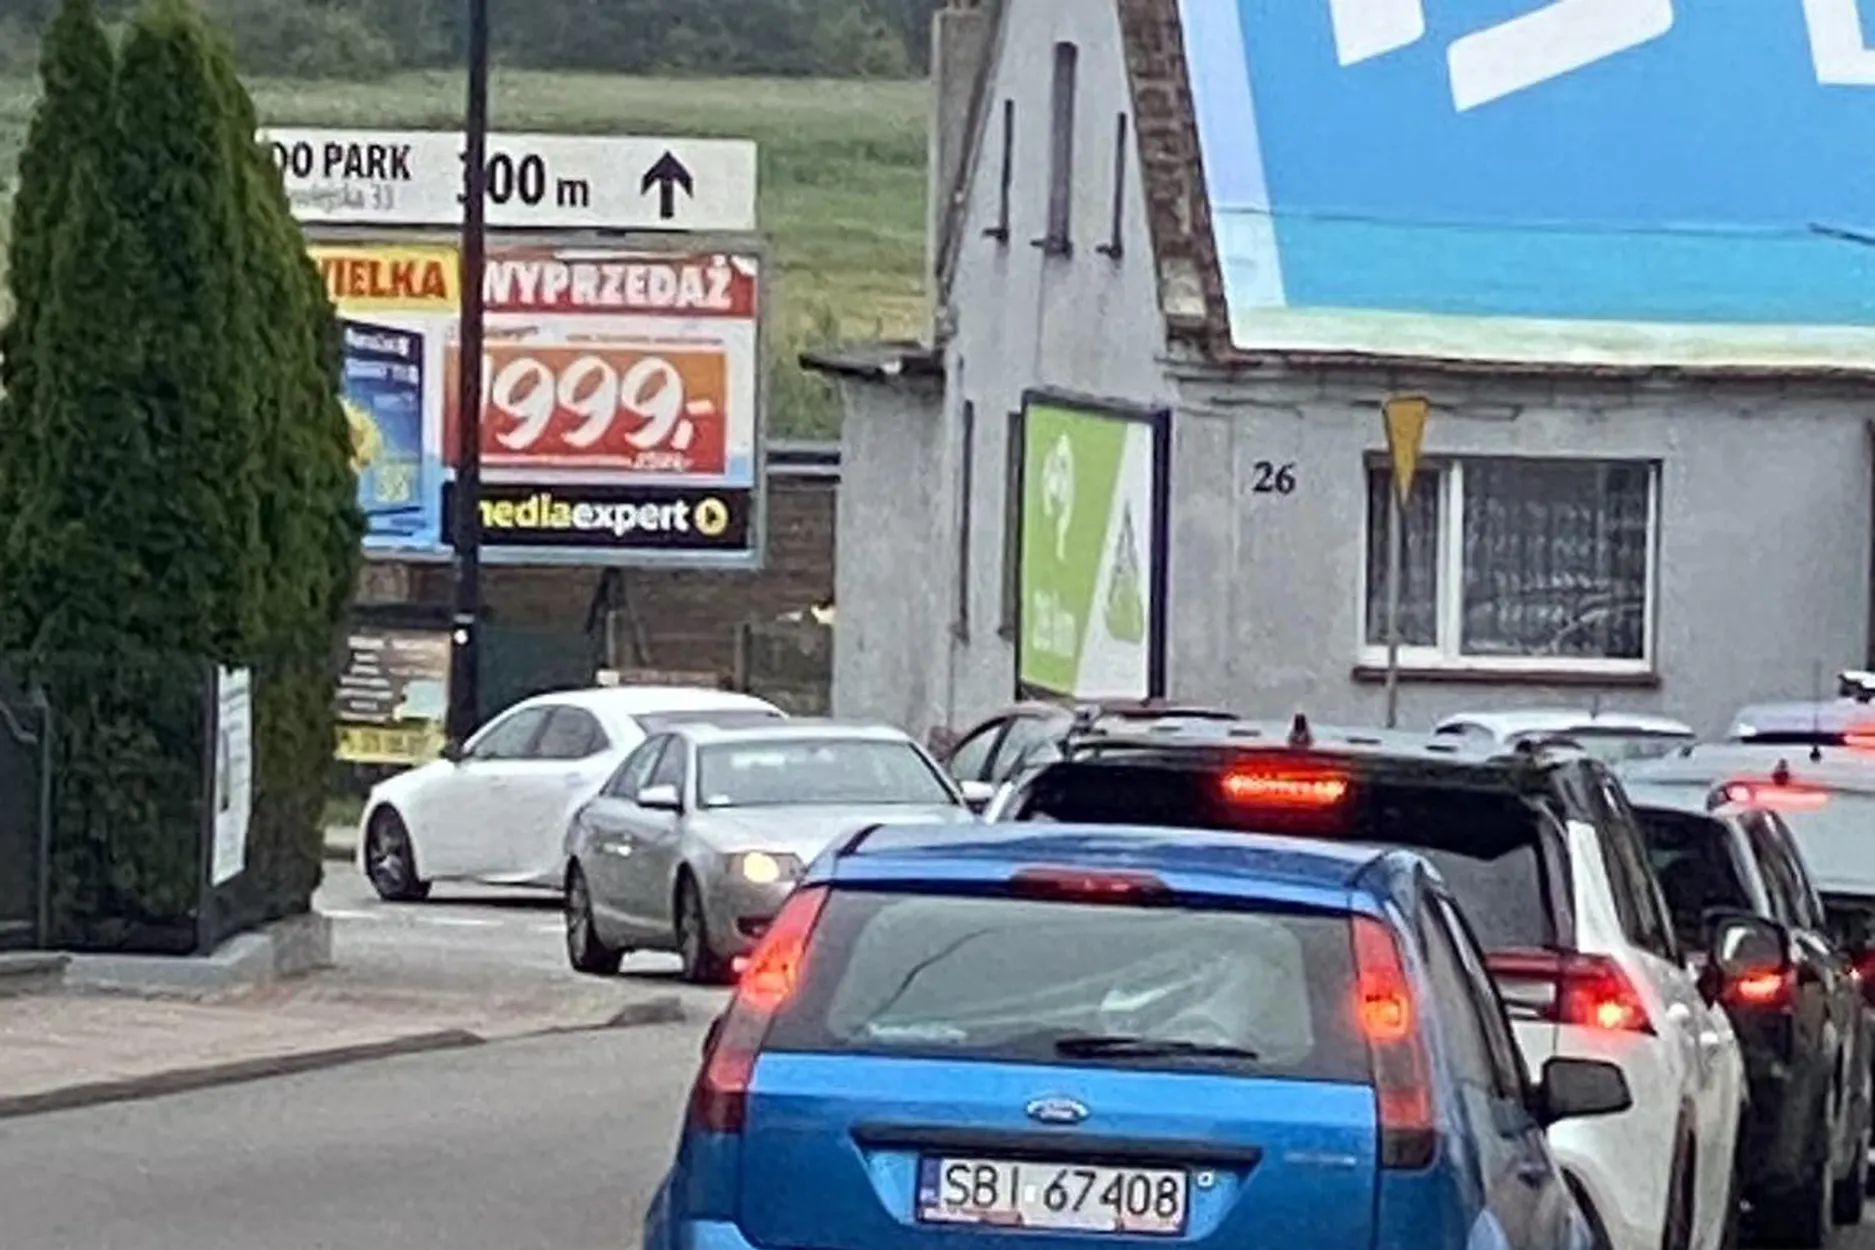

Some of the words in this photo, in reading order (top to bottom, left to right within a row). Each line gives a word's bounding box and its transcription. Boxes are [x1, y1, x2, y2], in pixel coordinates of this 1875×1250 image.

[323, 142, 411, 180] PARK
[557, 178, 590, 208] m
[1253, 460, 1298, 496] 26
[945, 1163, 1020, 1208] SBI
[1043, 1168, 1179, 1219] 67408
